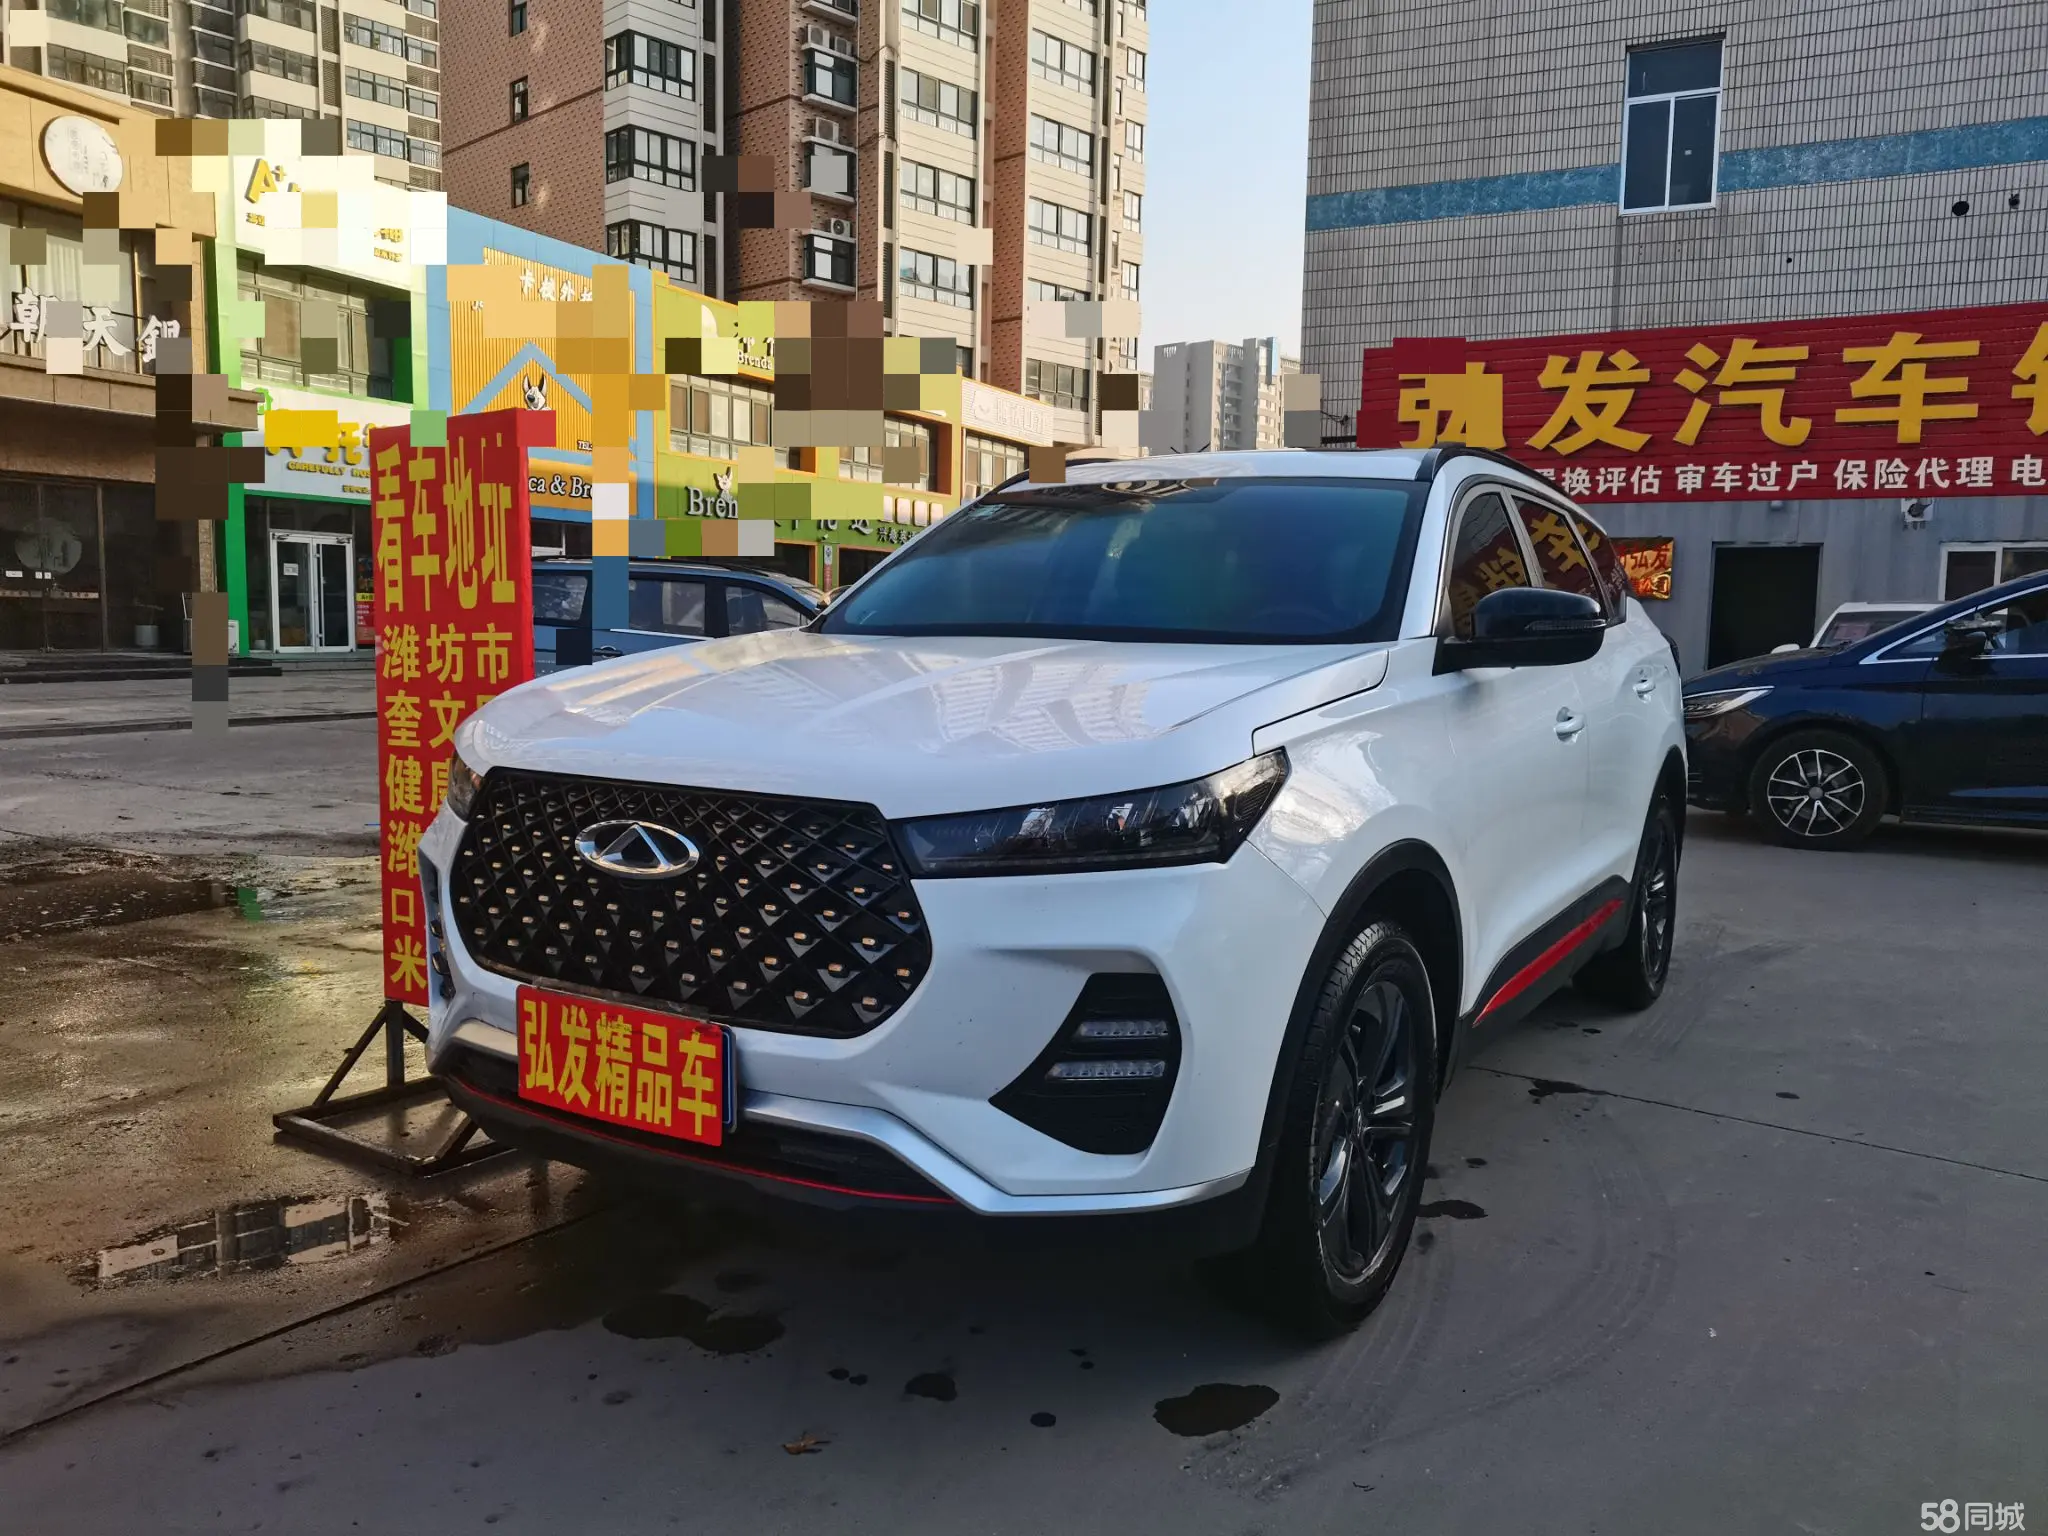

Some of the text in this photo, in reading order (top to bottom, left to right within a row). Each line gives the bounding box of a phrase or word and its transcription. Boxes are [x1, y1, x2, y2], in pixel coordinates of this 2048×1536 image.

[1676, 458, 1818, 494] 审车过户
[1834, 456, 1994, 491] 保险代理
[382, 623, 513, 684] 潍坊市
[385, 690, 499, 749] 奎文
[523, 999, 717, 1136] 弘发精品车
